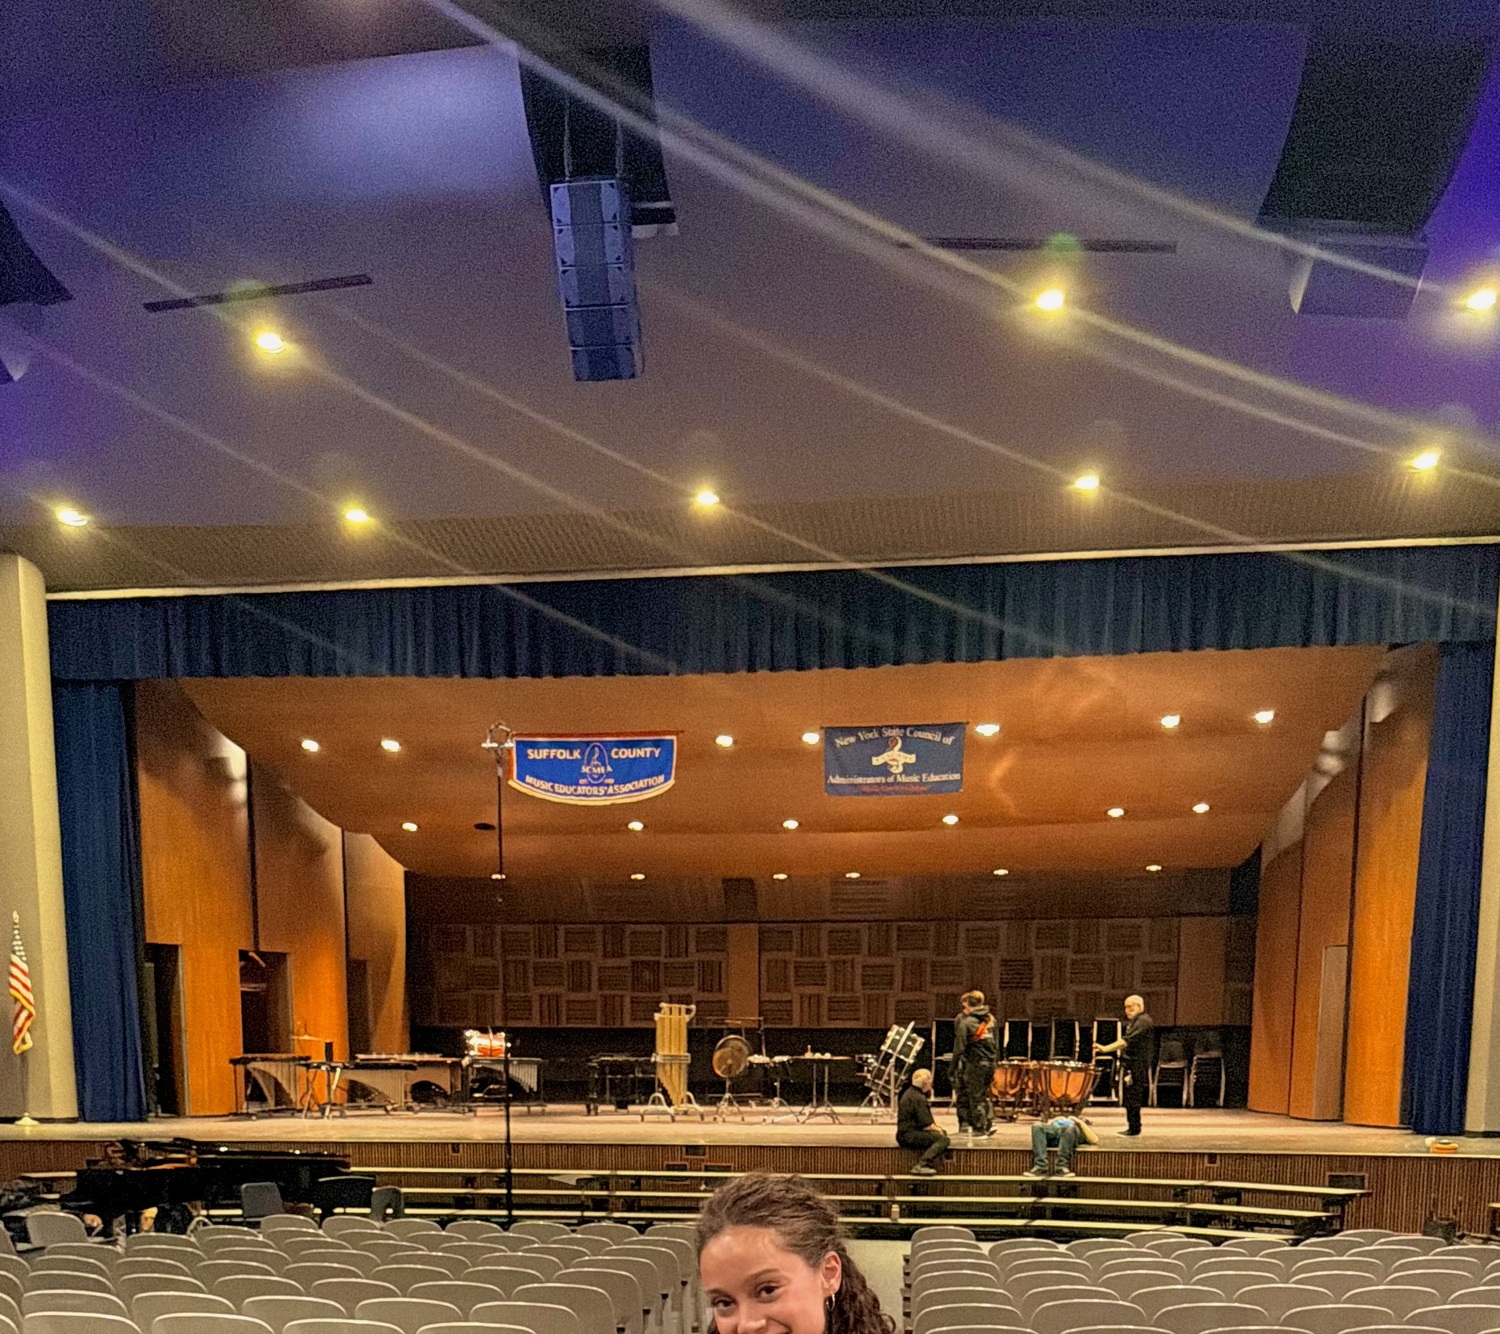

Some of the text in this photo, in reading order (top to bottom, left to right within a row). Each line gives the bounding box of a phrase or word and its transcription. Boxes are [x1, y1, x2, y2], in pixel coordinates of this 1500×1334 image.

[835, 727, 955, 748] New York State Council of
[527, 747, 661, 760] SUFFOLK COUNTY
[525, 775, 555, 791] MUSIC
[607, 774, 665, 794] ASSOCIATION
[886, 774, 896, 783] of
[896, 774, 920, 783] Music
[922, 772, 961, 782] Education
